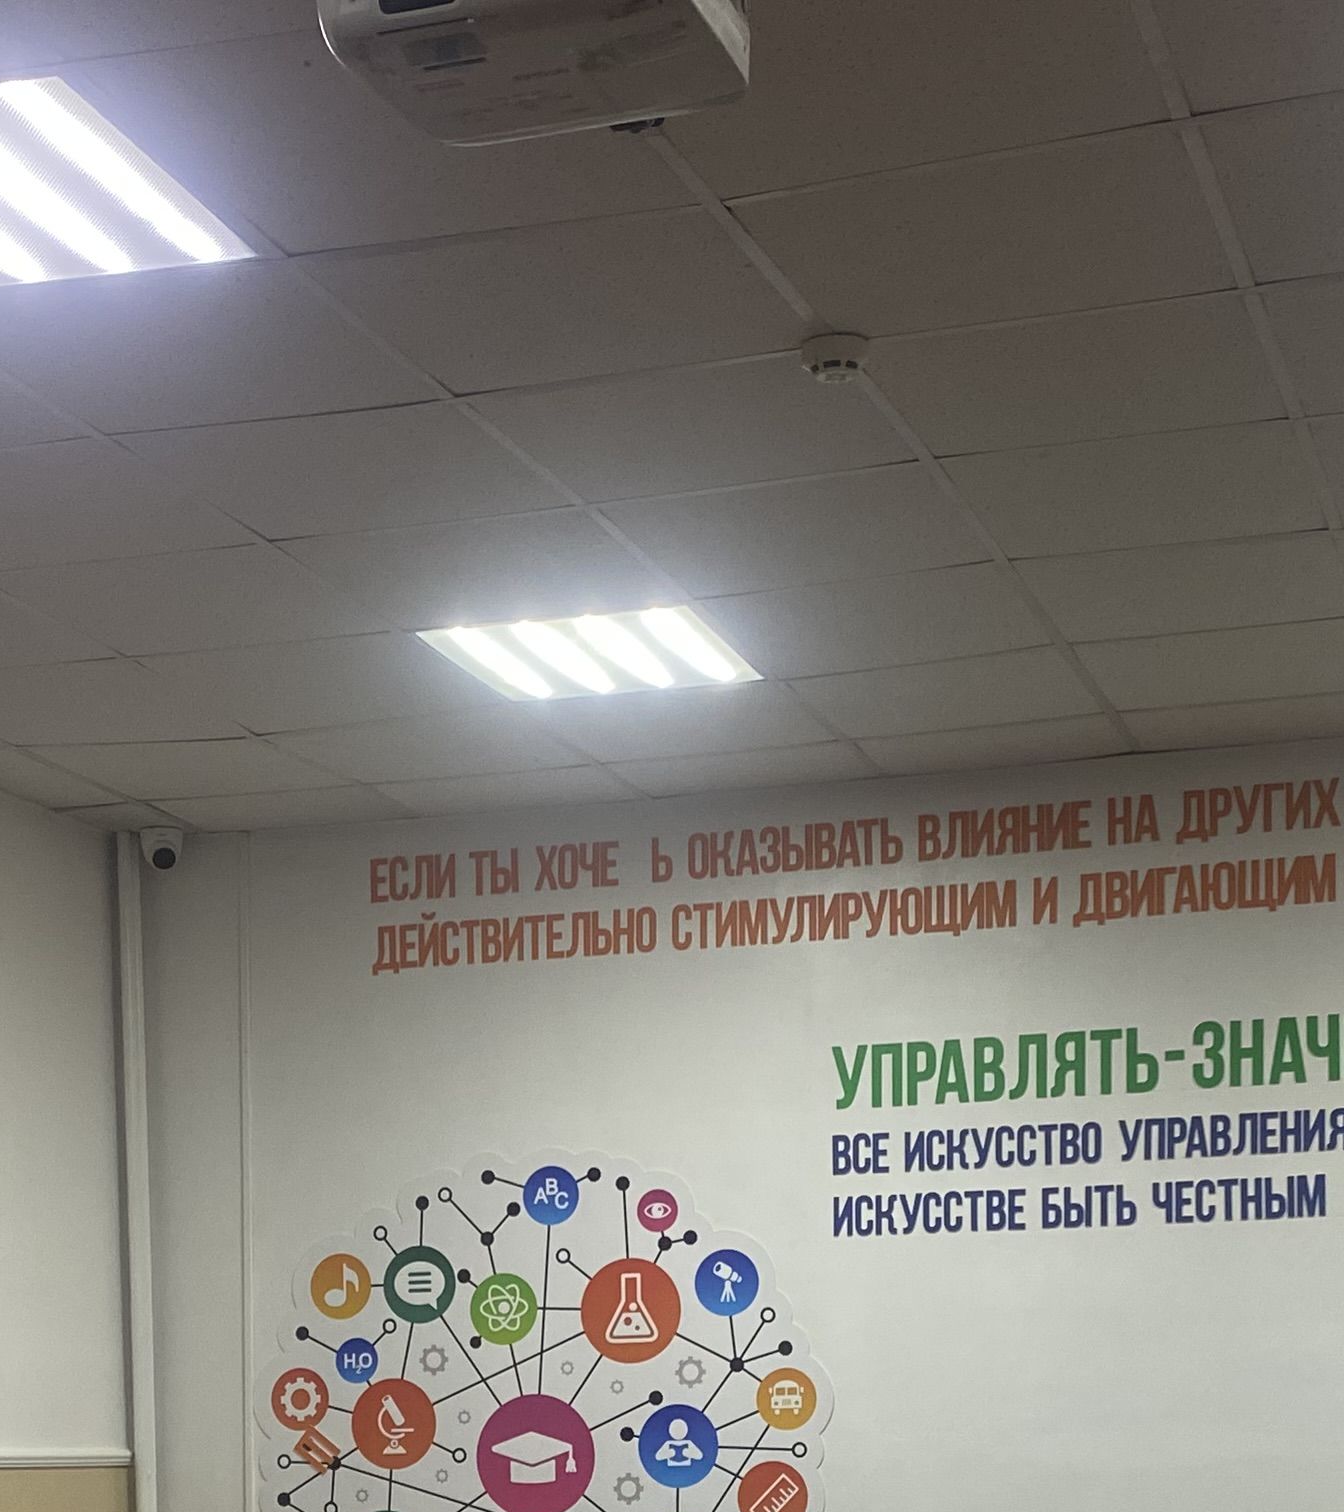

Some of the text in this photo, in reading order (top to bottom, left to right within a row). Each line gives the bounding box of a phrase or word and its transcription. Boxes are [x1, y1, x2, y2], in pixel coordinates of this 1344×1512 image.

[369, 852, 456, 904] ЕСЛИ
[469, 849, 519, 896] ТЫ
[688, 816, 904, 879] ОКАЗЫВАТЬ
[917, 800, 1092, 862] ВЛИЯНИЕ
[1107, 794, 1160, 847] НА
[1176, 777, 1341, 844] ДРУГИХ
[371, 905, 658, 976] ДЕЙСТВИТЕЛЬНО
[671, 878, 1017, 952] СТИМУЛИРУЮЩИМ
[1032, 876, 1059, 925] И
[1072, 851, 1337, 928] ДВИГАЮЩИМ
[831, 1132, 889, 1174] ВСЕ
[904, 1121, 1103, 1169] ИСКУССТВО
[533, 1177, 570, 1210] ABC
[832, 1174, 1327, 1237] ИСКУССТВЕ БЫТЬ ЧЕСТНЫМ
